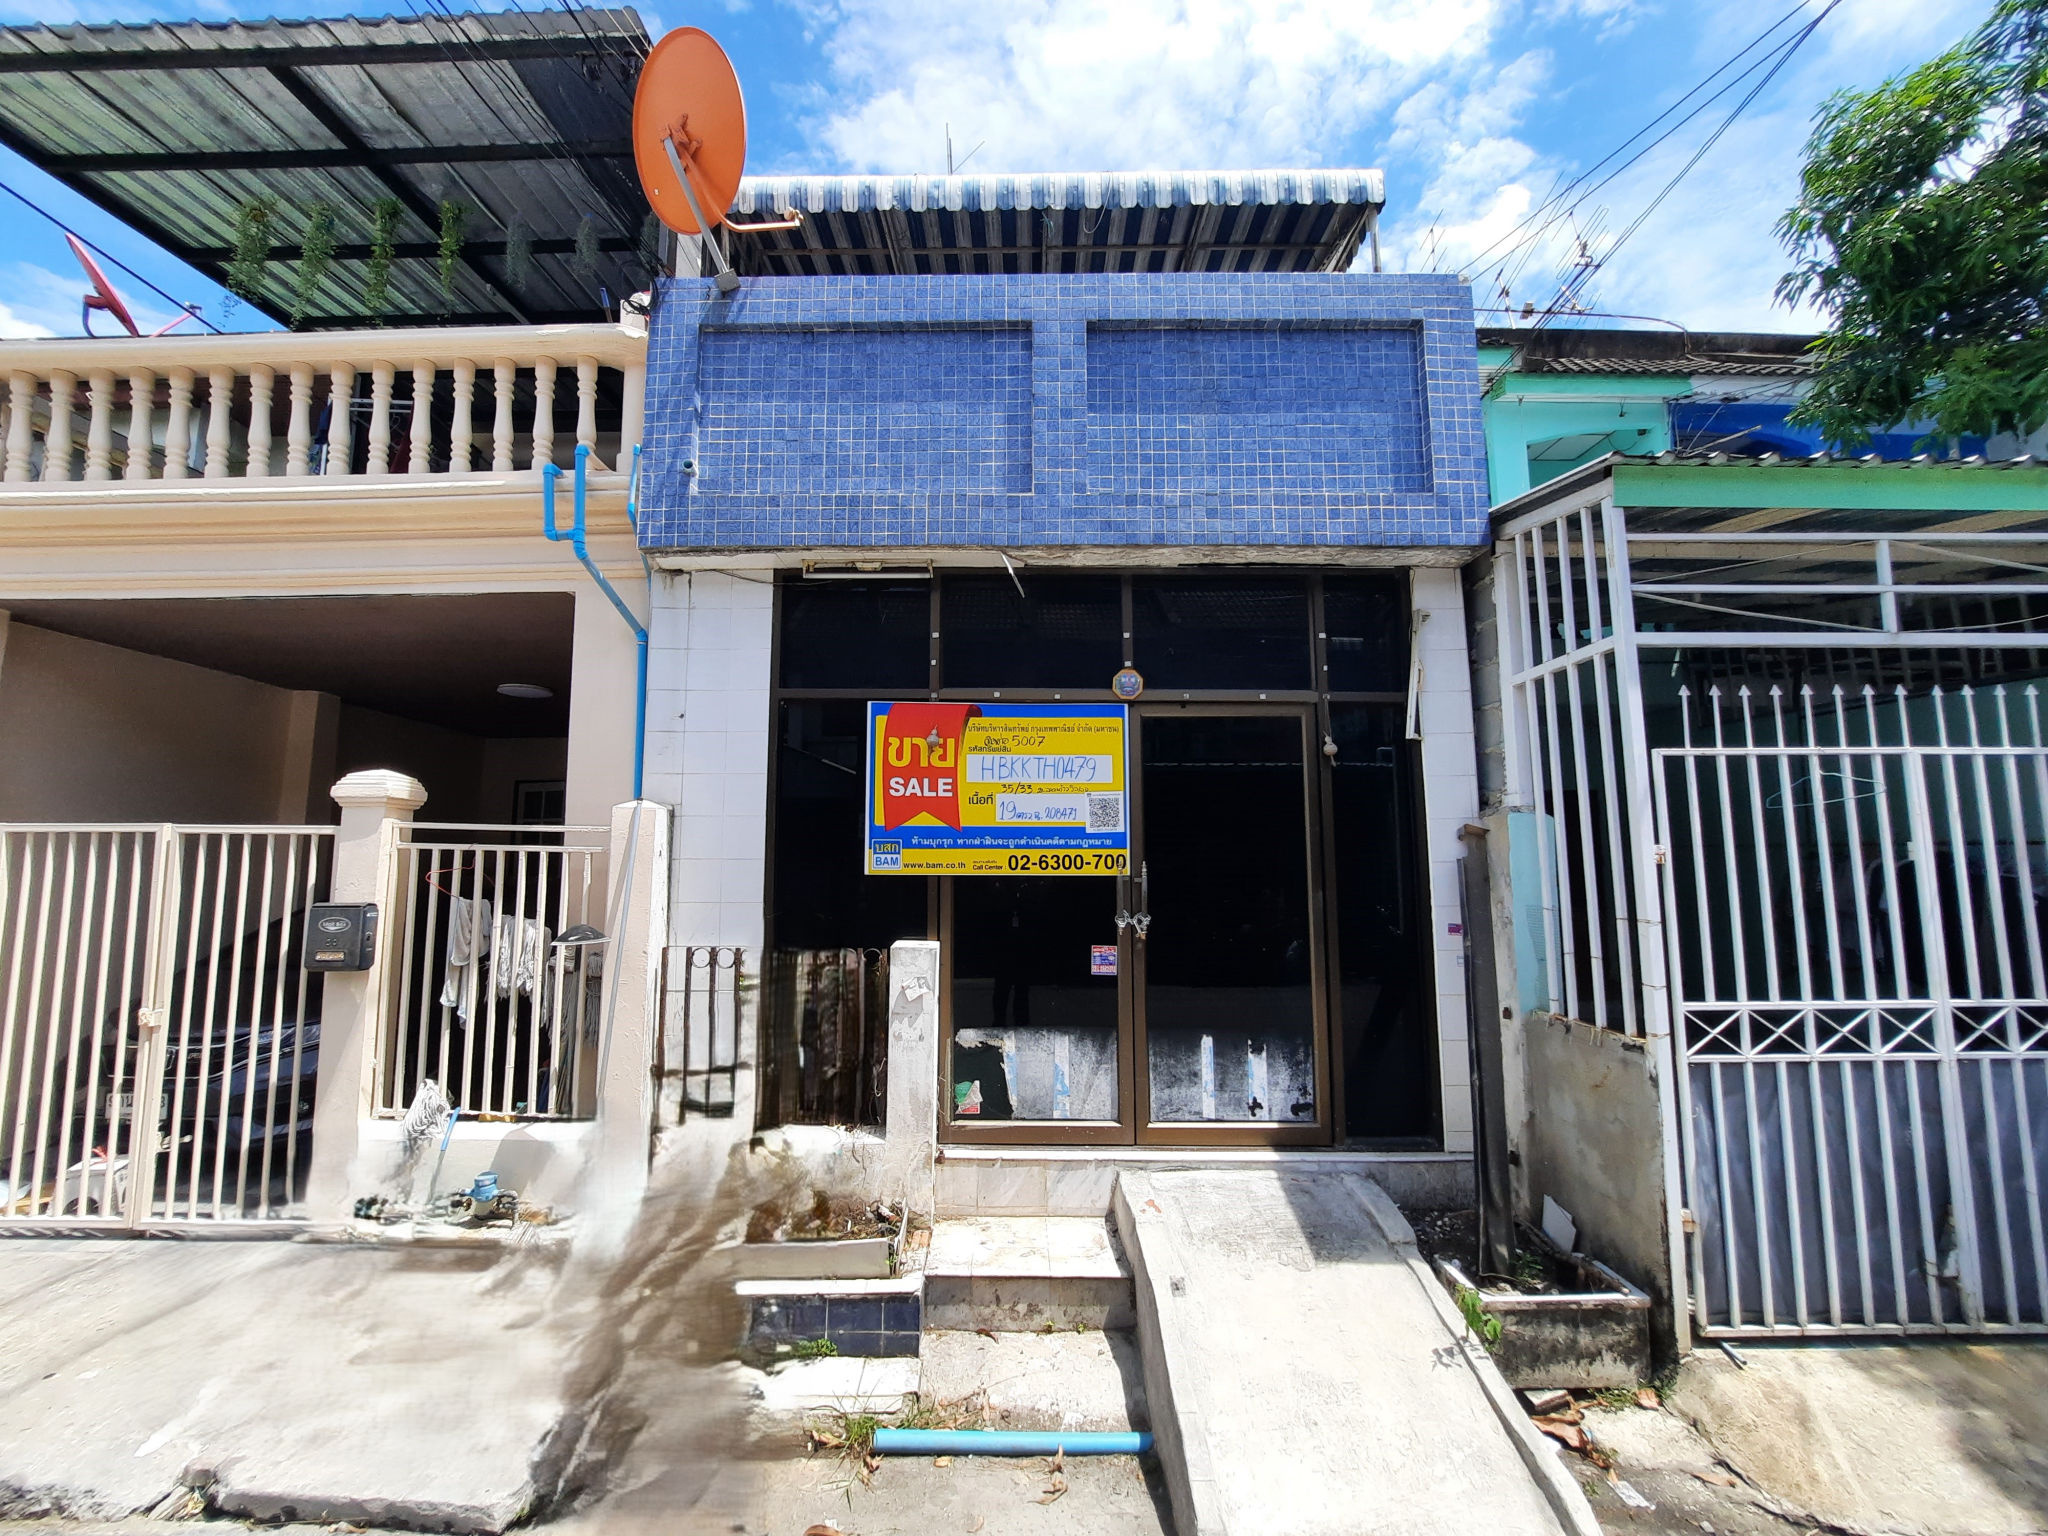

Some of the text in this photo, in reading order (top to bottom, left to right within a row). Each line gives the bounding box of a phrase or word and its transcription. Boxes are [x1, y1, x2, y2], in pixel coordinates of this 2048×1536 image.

[1012, 735, 1045, 747] 5007
[888, 737, 955, 767] ขาย
[889, 777, 953, 797] SALE
[1001, 782, 1033, 794] 35/33
[968, 792, 993, 805] เนื้อที่
[875, 843, 899, 852] บสก
[912, 836, 953, 848] ห้ามบุกรุก
[875, 856, 899, 866] BAM
[1008, 854, 1126, 871] 02-6300-700
